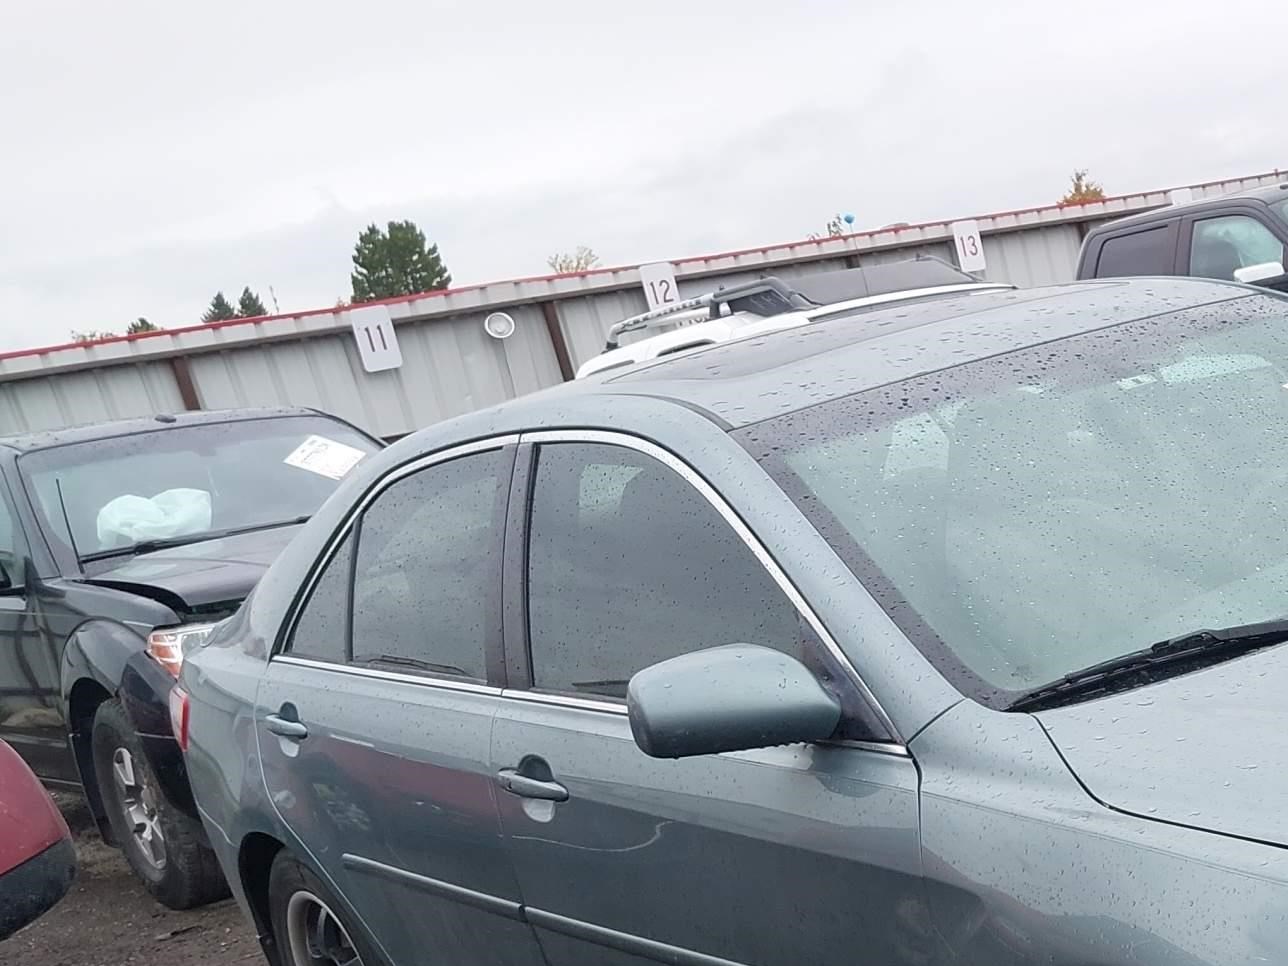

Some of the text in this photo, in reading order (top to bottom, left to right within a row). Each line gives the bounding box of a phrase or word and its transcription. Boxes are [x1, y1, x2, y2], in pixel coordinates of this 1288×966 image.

[959, 235, 978, 257] 13
[649, 279, 675, 305] 12
[364, 324, 388, 353] 11
